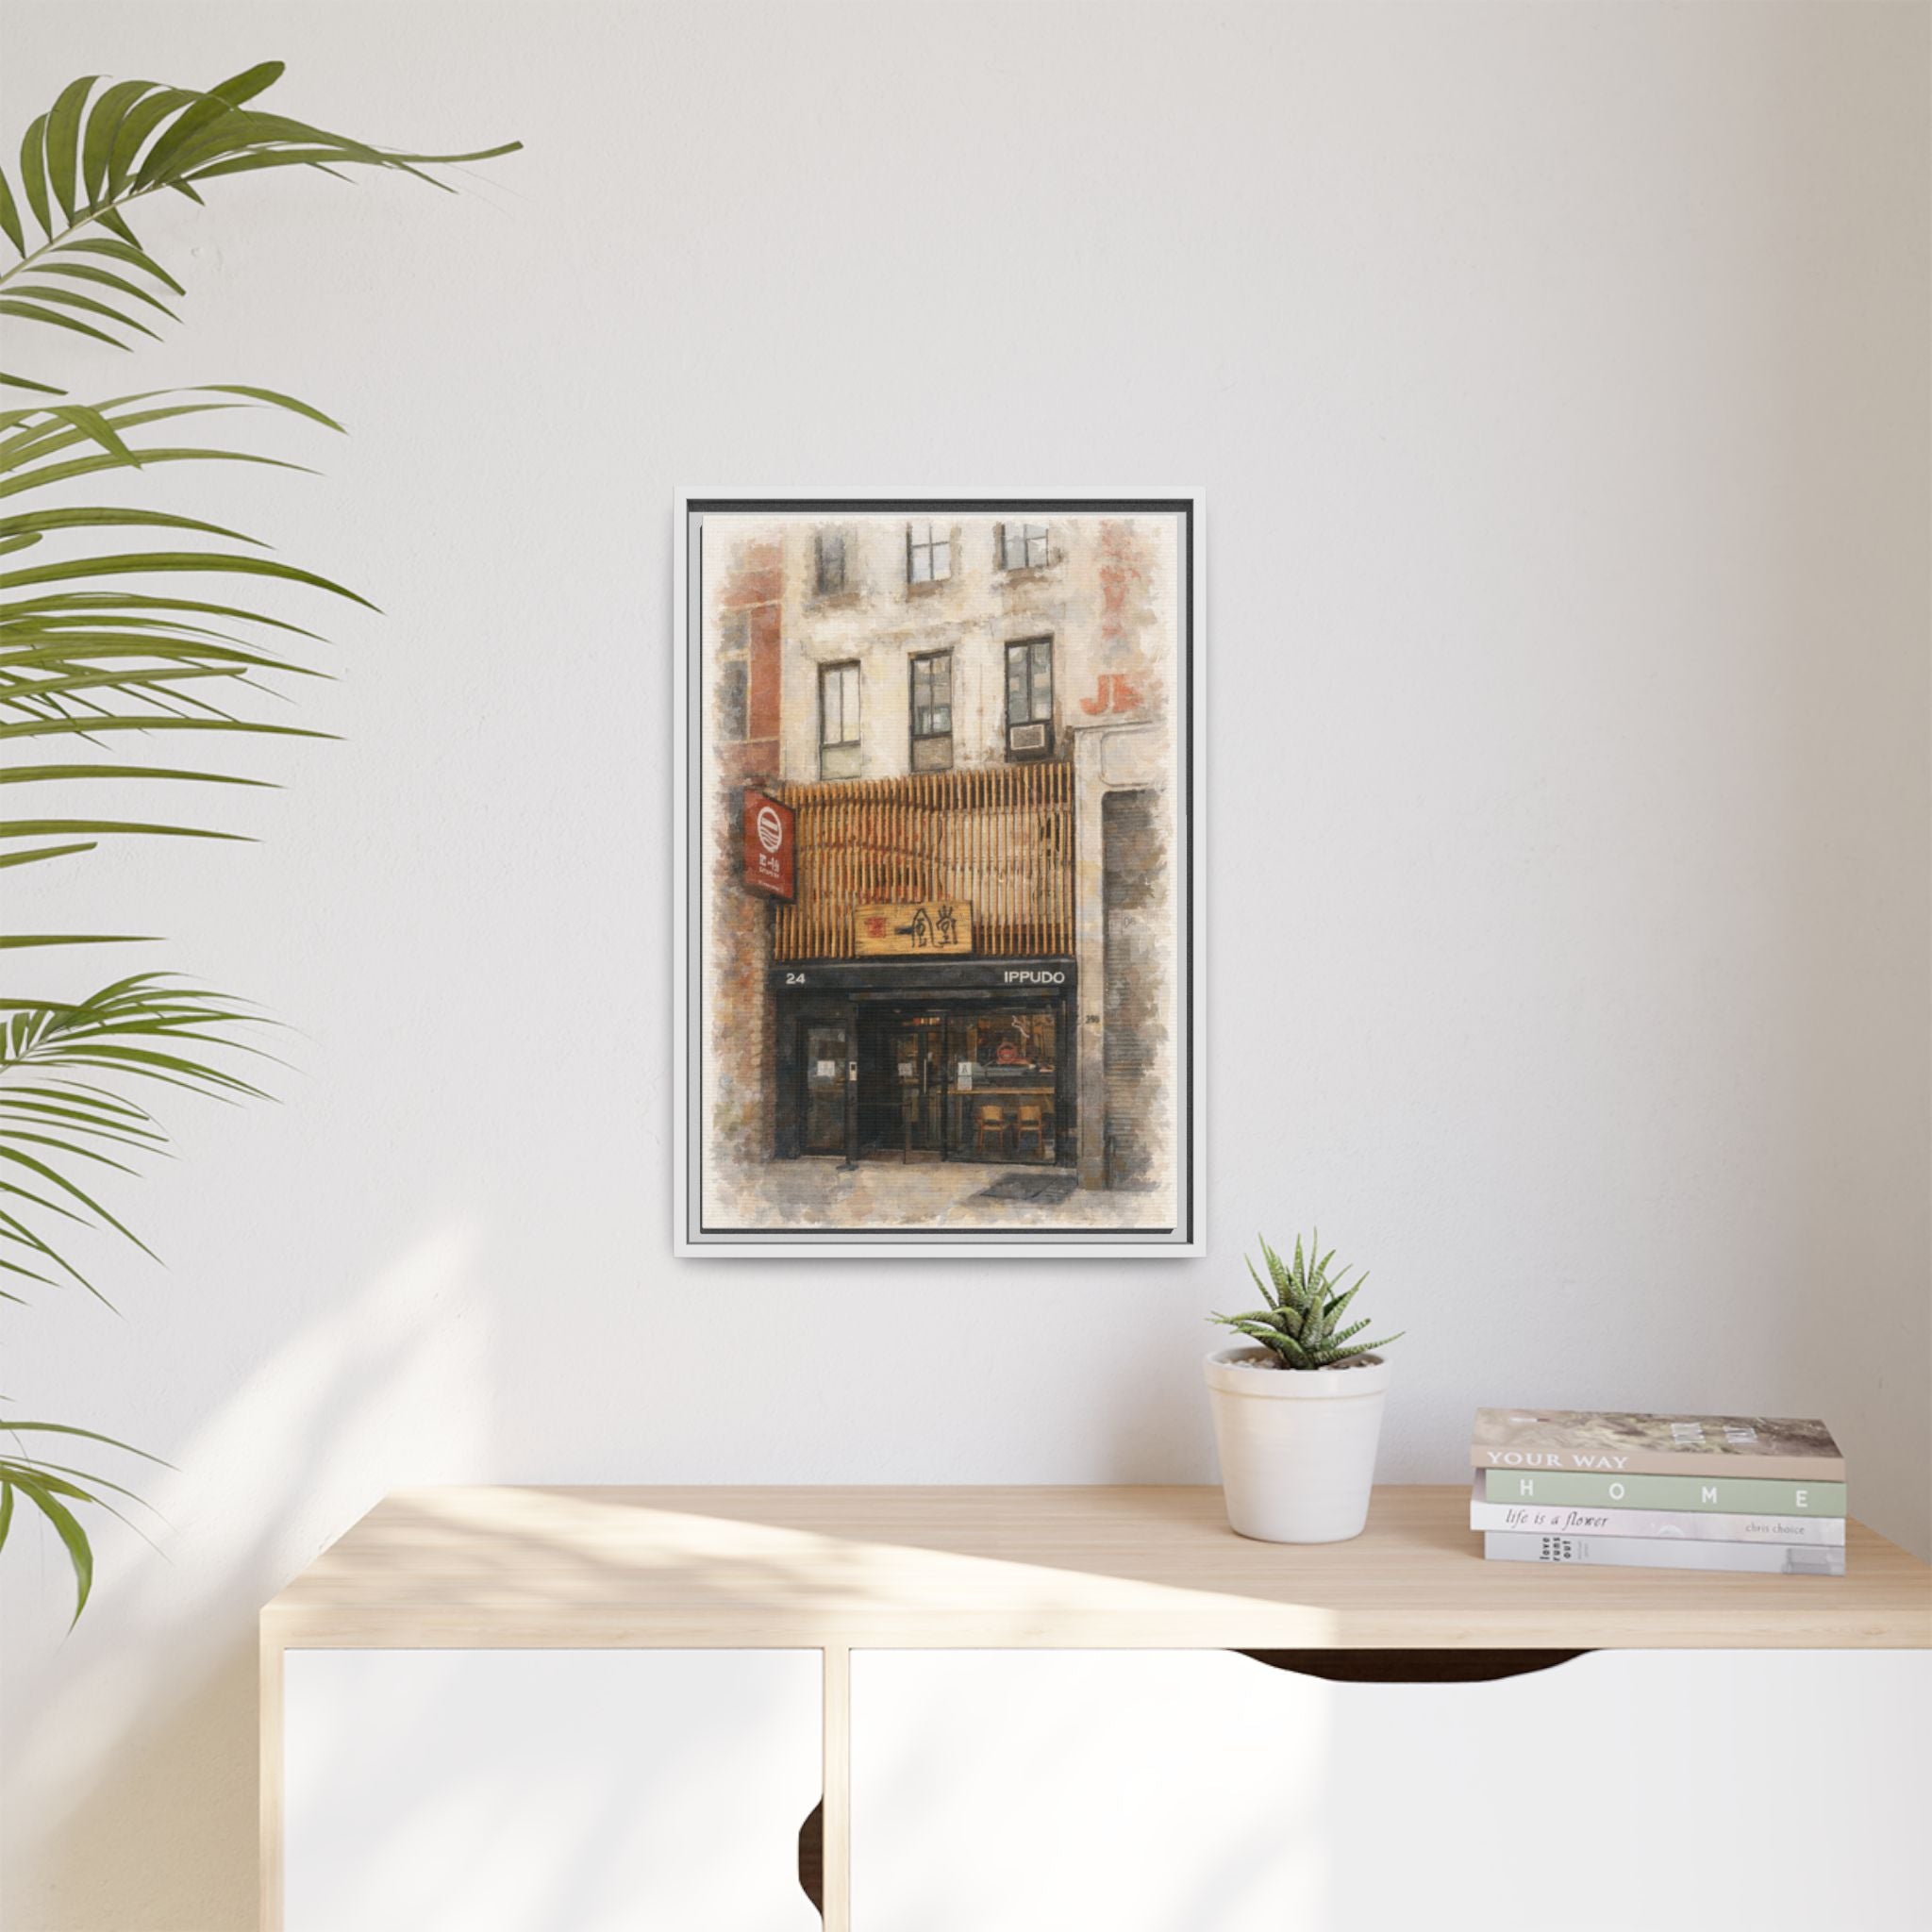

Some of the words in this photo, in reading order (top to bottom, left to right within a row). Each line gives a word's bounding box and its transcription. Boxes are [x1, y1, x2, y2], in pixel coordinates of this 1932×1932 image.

[786, 973, 806, 984] 24
[1004, 971, 1065, 984] IPPUDO
[1488, 1451, 1562, 1467] YOUR
[1573, 1455, 1629, 1469] WAY
[1506, 1509, 1528, 1528] life
[1534, 1512, 1547, 1524] is
[1551, 1517, 1559, 1525] a
[1562, 1511, 1609, 1531] flower
[1745, 1522, 1770, 1533] chris
[1772, 1523, 1805, 1535] choice
[1540, 1537, 1550, 1559] love
[1553, 1537, 1561, 1561] runs
[1562, 1541, 1572, 1558] out
